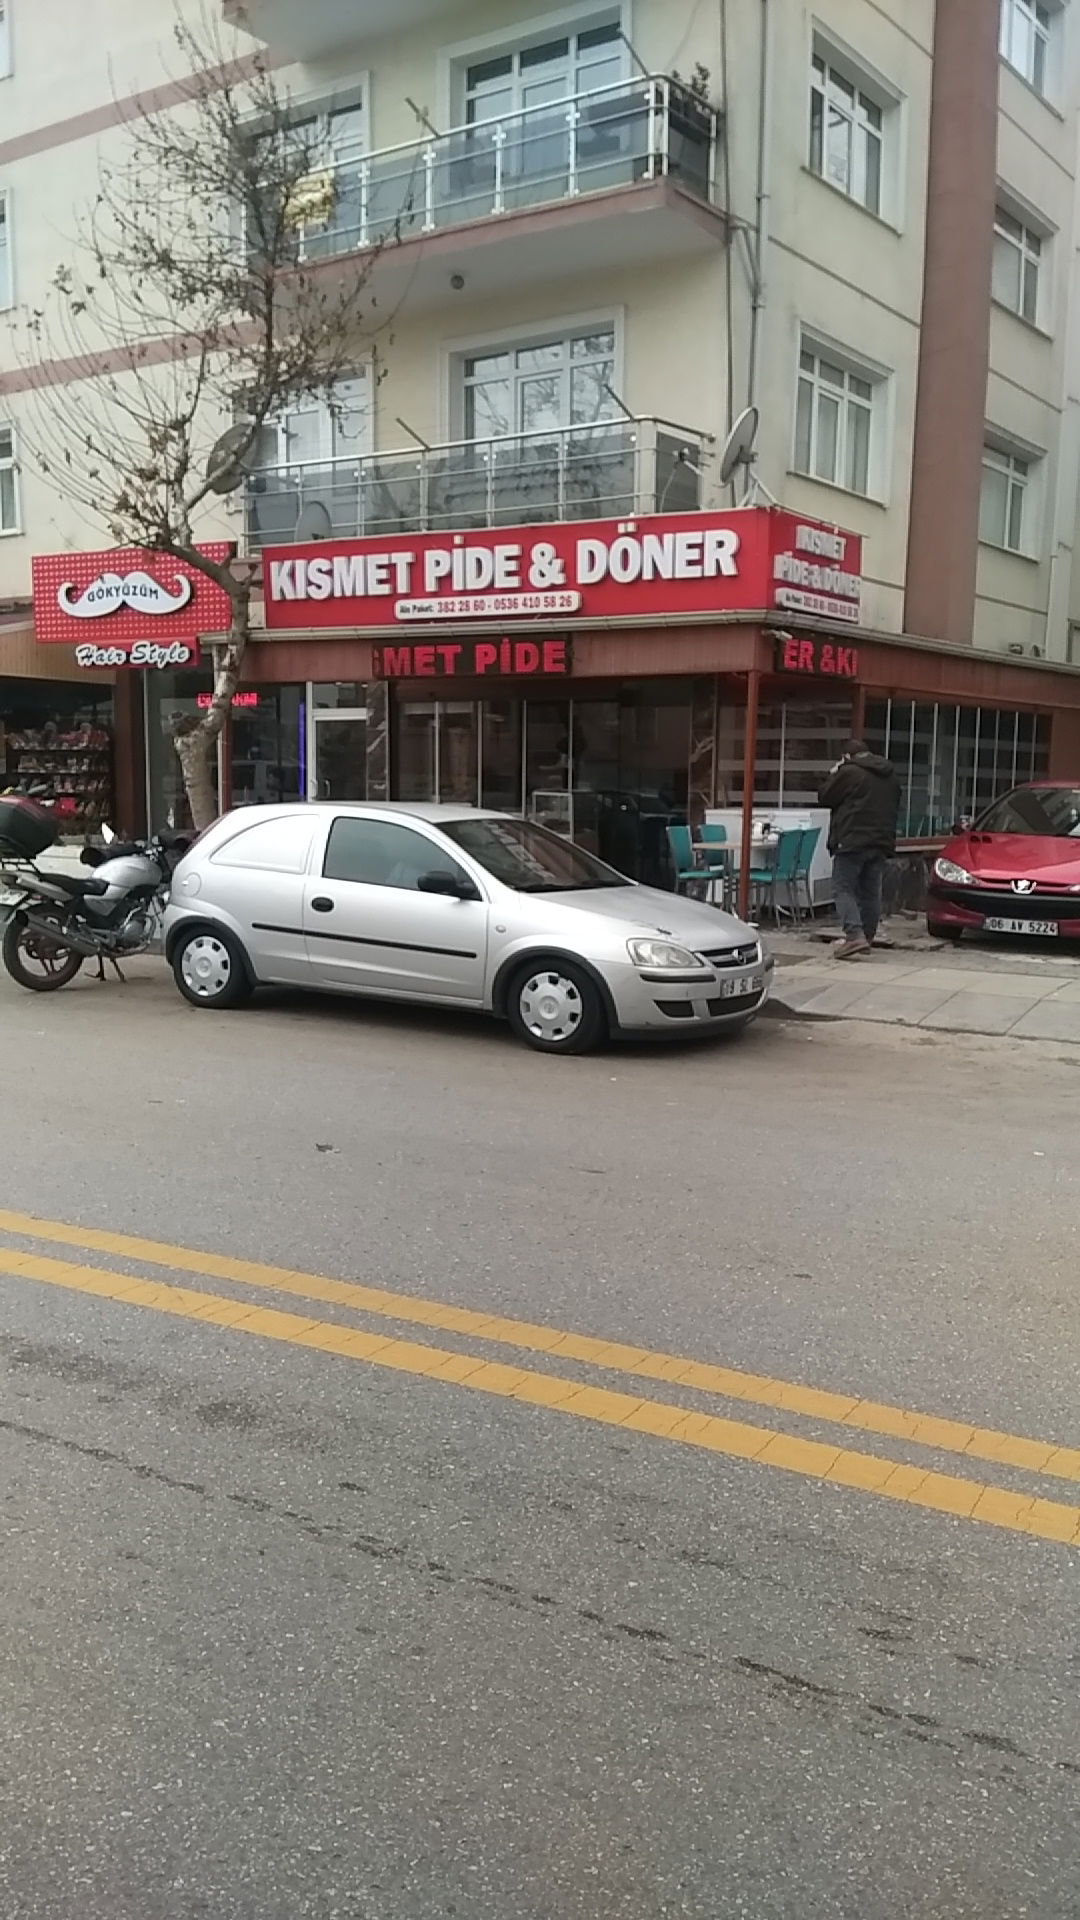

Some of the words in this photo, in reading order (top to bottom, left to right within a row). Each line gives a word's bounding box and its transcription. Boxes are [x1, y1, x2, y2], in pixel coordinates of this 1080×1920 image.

[270, 552, 417, 601] KISMET
[424, 534, 521, 592] PİDE
[529, 542, 567, 588] &
[576, 522, 739, 585] DÖNER
[87, 584, 159, 602] GÖKYÜZÜM
[521, 595, 541, 609] 410
[76, 643, 126, 665] Hair
[130, 641, 190, 669] Style
[474, 637, 567, 674] PİDE
[784, 639, 815, 673] ER
[991, 918, 1004, 929] 06
[1011, 921, 1024, 932] AV
[1029, 921, 1056, 933] 5224
